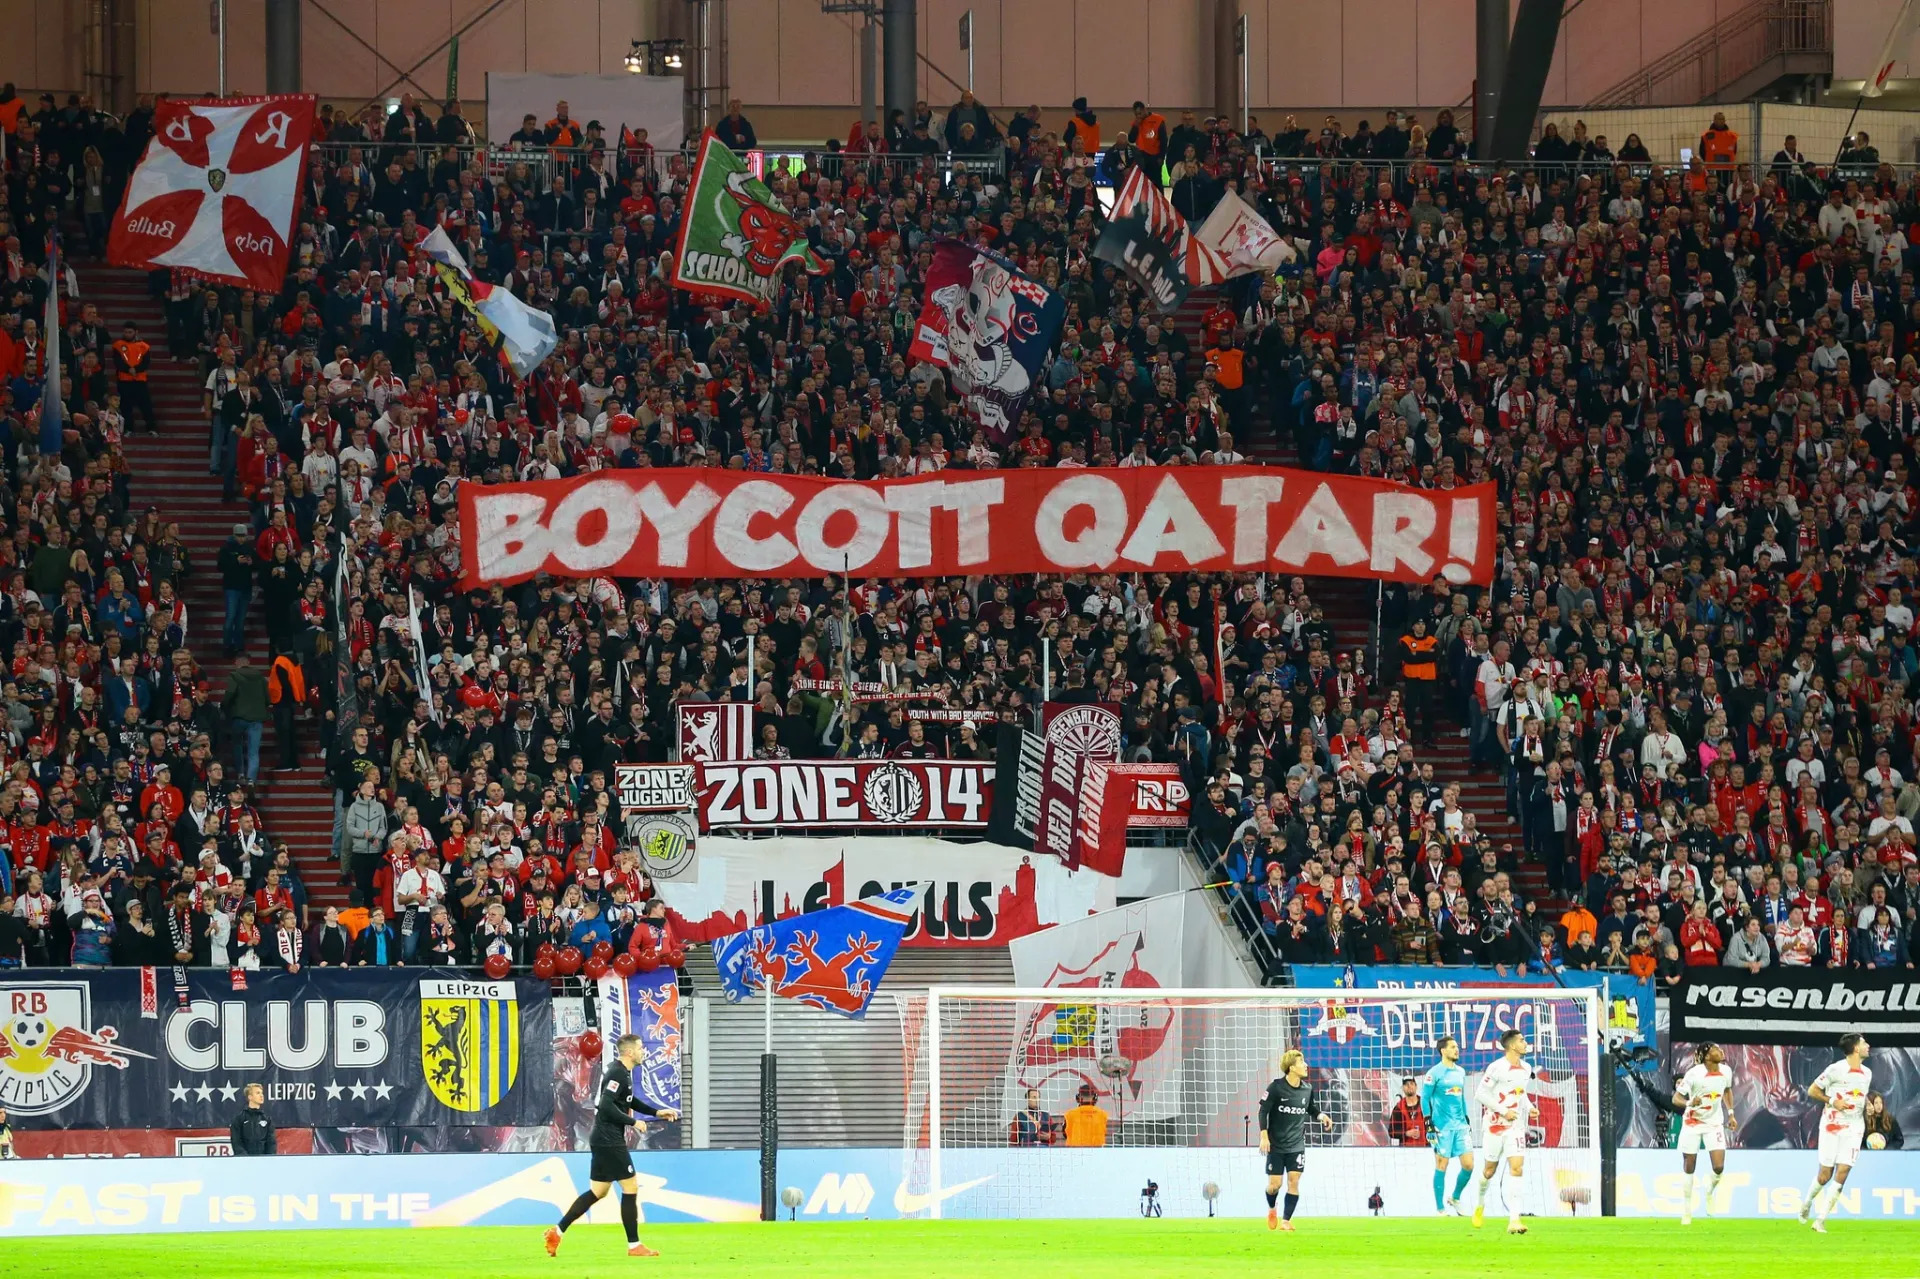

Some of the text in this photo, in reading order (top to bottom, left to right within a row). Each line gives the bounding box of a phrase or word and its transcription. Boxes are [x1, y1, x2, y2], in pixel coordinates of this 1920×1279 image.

[475, 474, 1480, 585] BOYCOTT QATAR!
[908, 709, 929, 720] YOUTH
[930, 710, 948, 720] WITH
[618, 769, 685, 789] ZONE
[1052, 745, 1079, 796] DR
[618, 789, 687, 805] JUGEND
[704, 766, 859, 822] ZONE
[1131, 778, 1191, 812] RP
[11, 992, 48, 1014] RB
[437, 983, 499, 997] LEIPZIG
[165, 1000, 391, 1071] CLUB
[1383, 1003, 1557, 1052] DELITZSCH
[0, 1068, 71, 1105] EIPZIG
[267, 1083, 316, 1100] LEIPZIG
[0, 1181, 203, 1227] FAST
[208, 1195, 256, 1223] IS
[268, 1193, 319, 1222] IN
[330, 1192, 430, 1221] THE
[1757, 1187, 1792, 1214] IS
